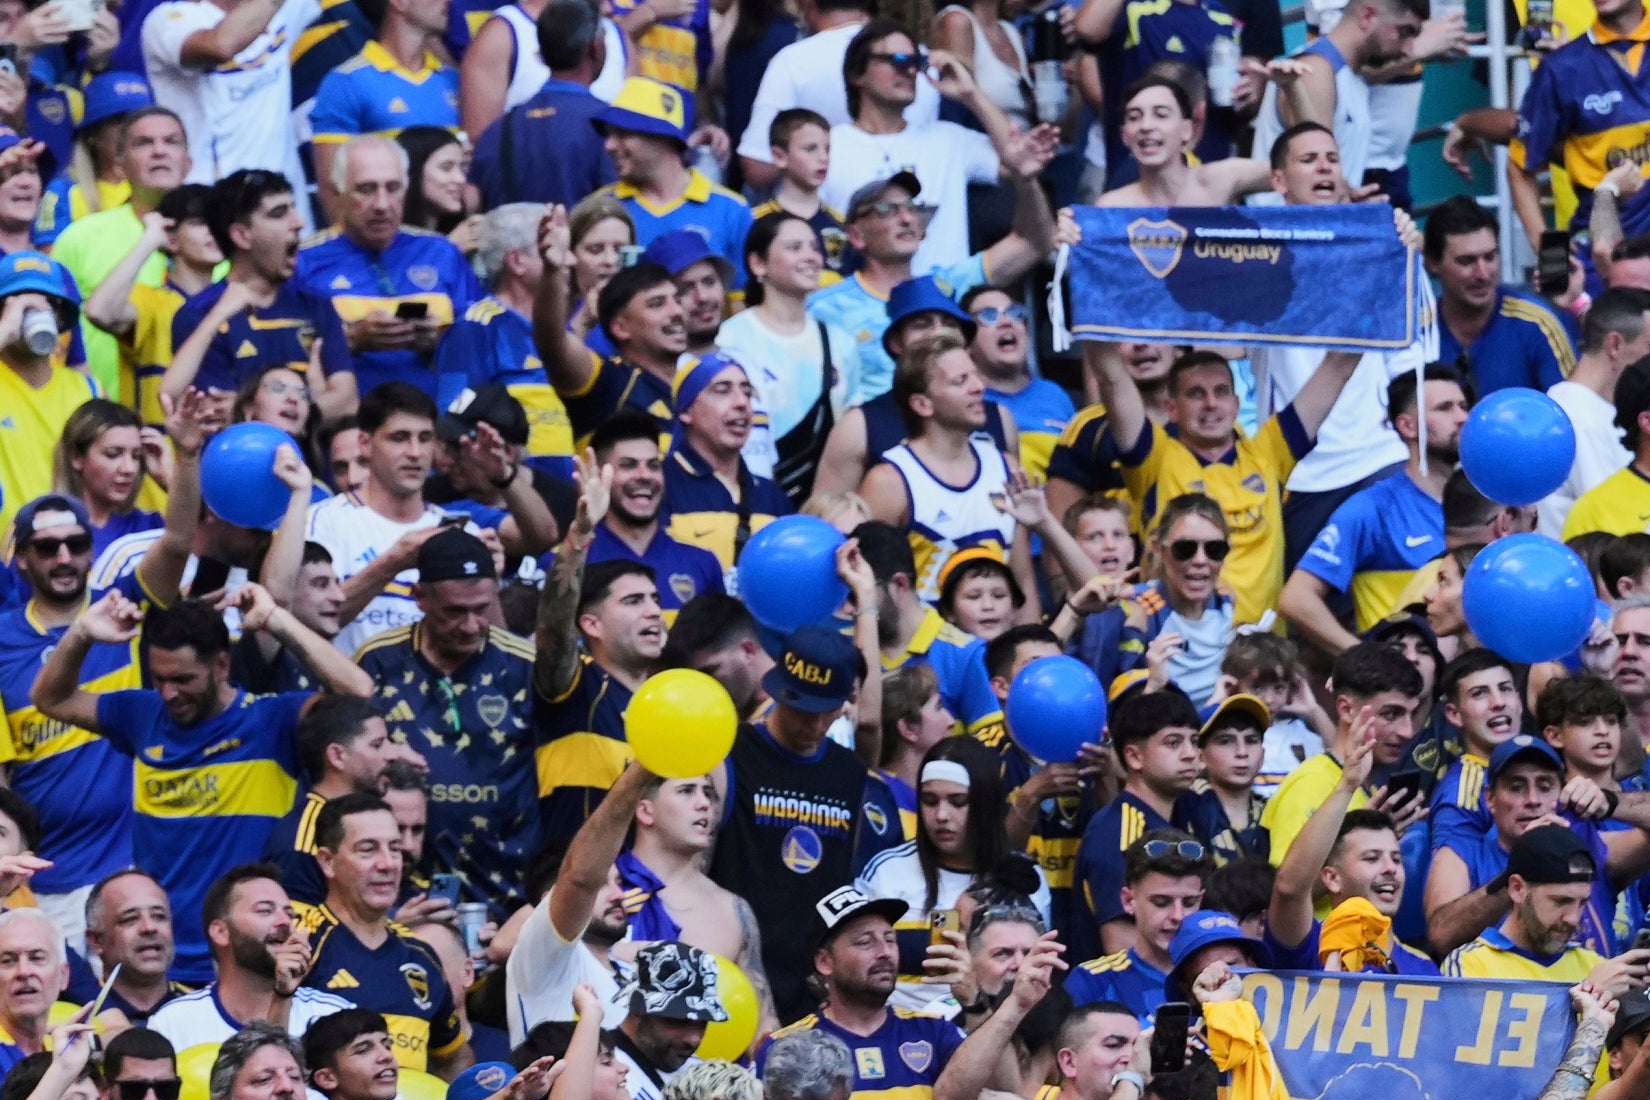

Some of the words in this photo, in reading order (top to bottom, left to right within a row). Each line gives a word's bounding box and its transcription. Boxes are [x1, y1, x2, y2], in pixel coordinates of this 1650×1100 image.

[1192, 240, 1281, 264] Uruguay
[784, 650, 832, 686] CABJ
[430, 782, 498, 804] sson
[753, 793, 850, 827] WARRIORS
